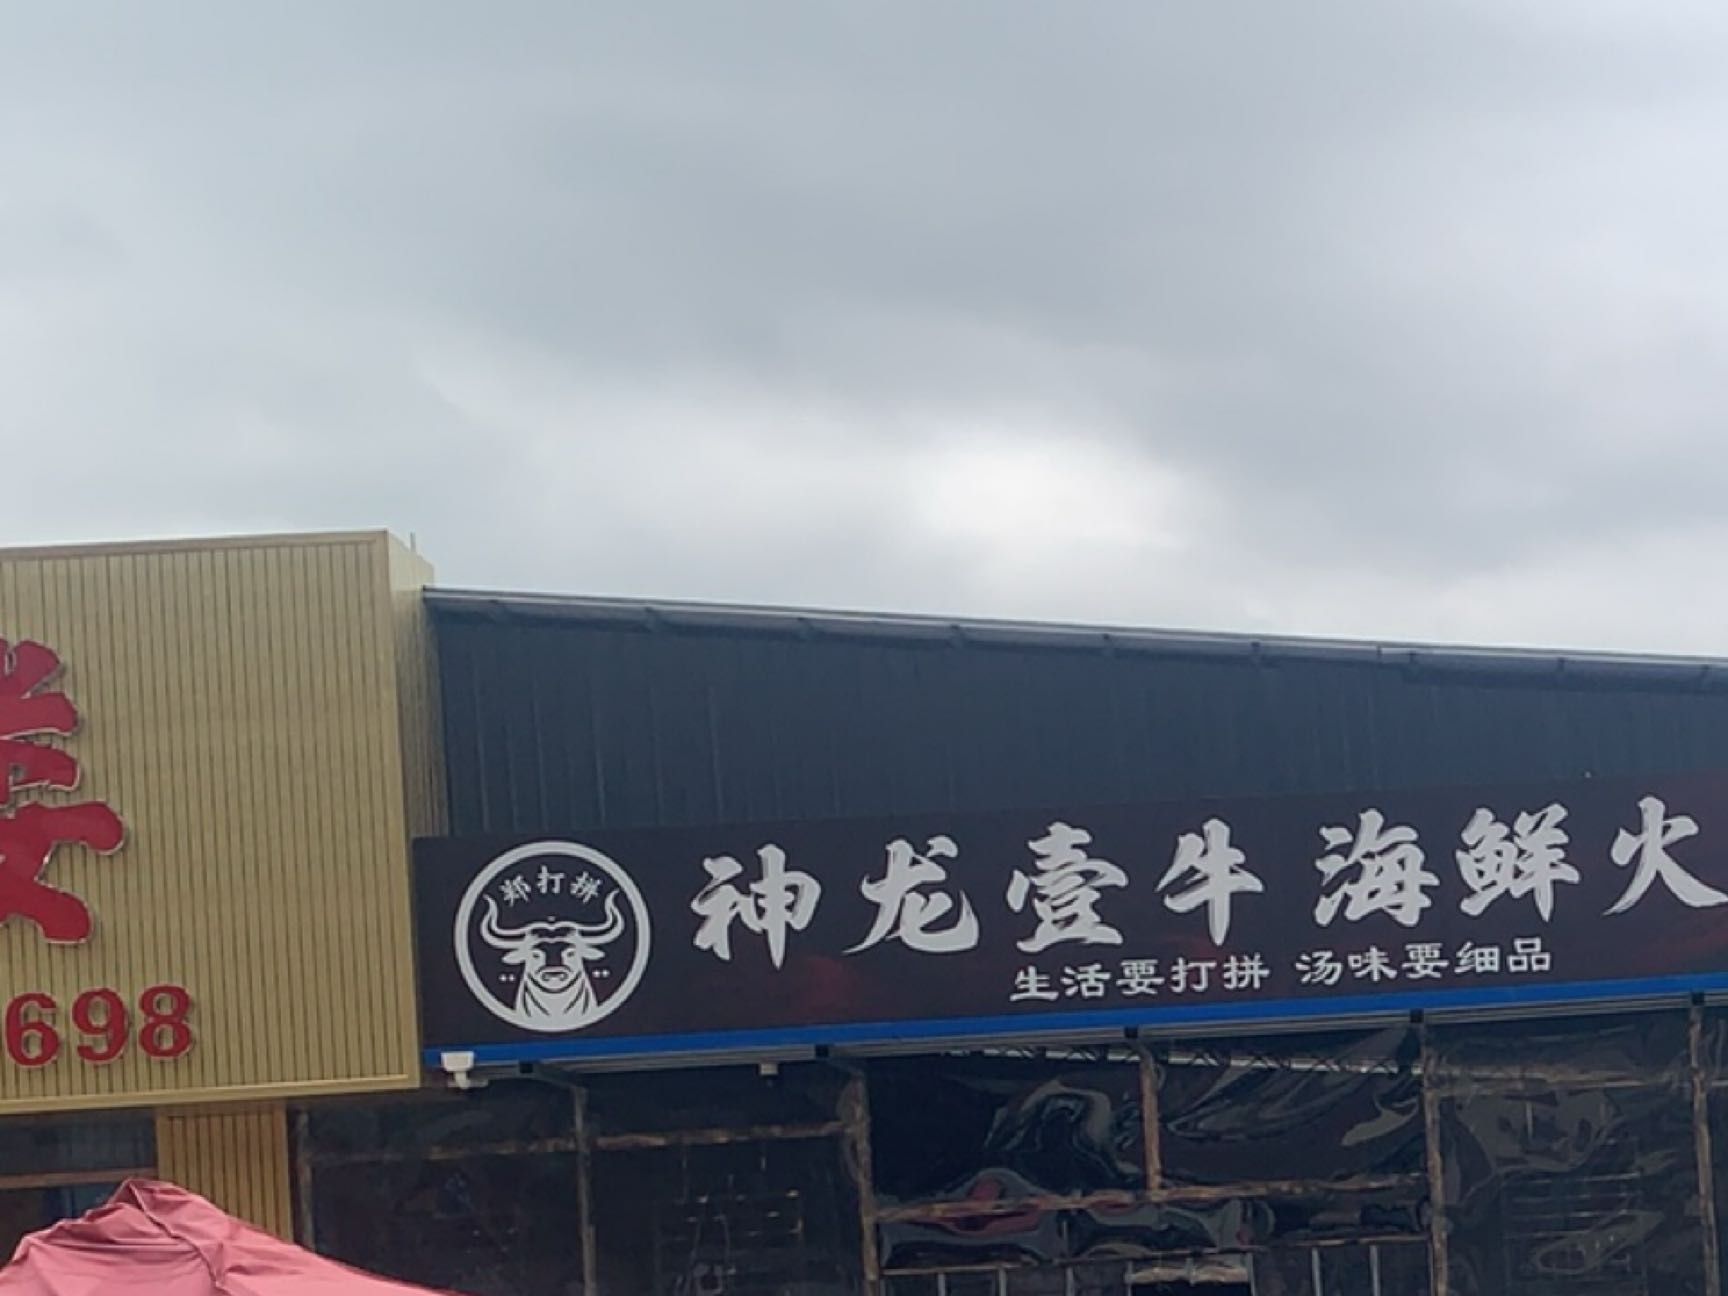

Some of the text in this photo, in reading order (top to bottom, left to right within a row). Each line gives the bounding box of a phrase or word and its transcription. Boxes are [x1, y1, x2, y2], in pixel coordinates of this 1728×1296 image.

[1009, 937, 1553, 1003] 生活要打拼 汤味要细品
[4, 984, 193, 1068] 698
